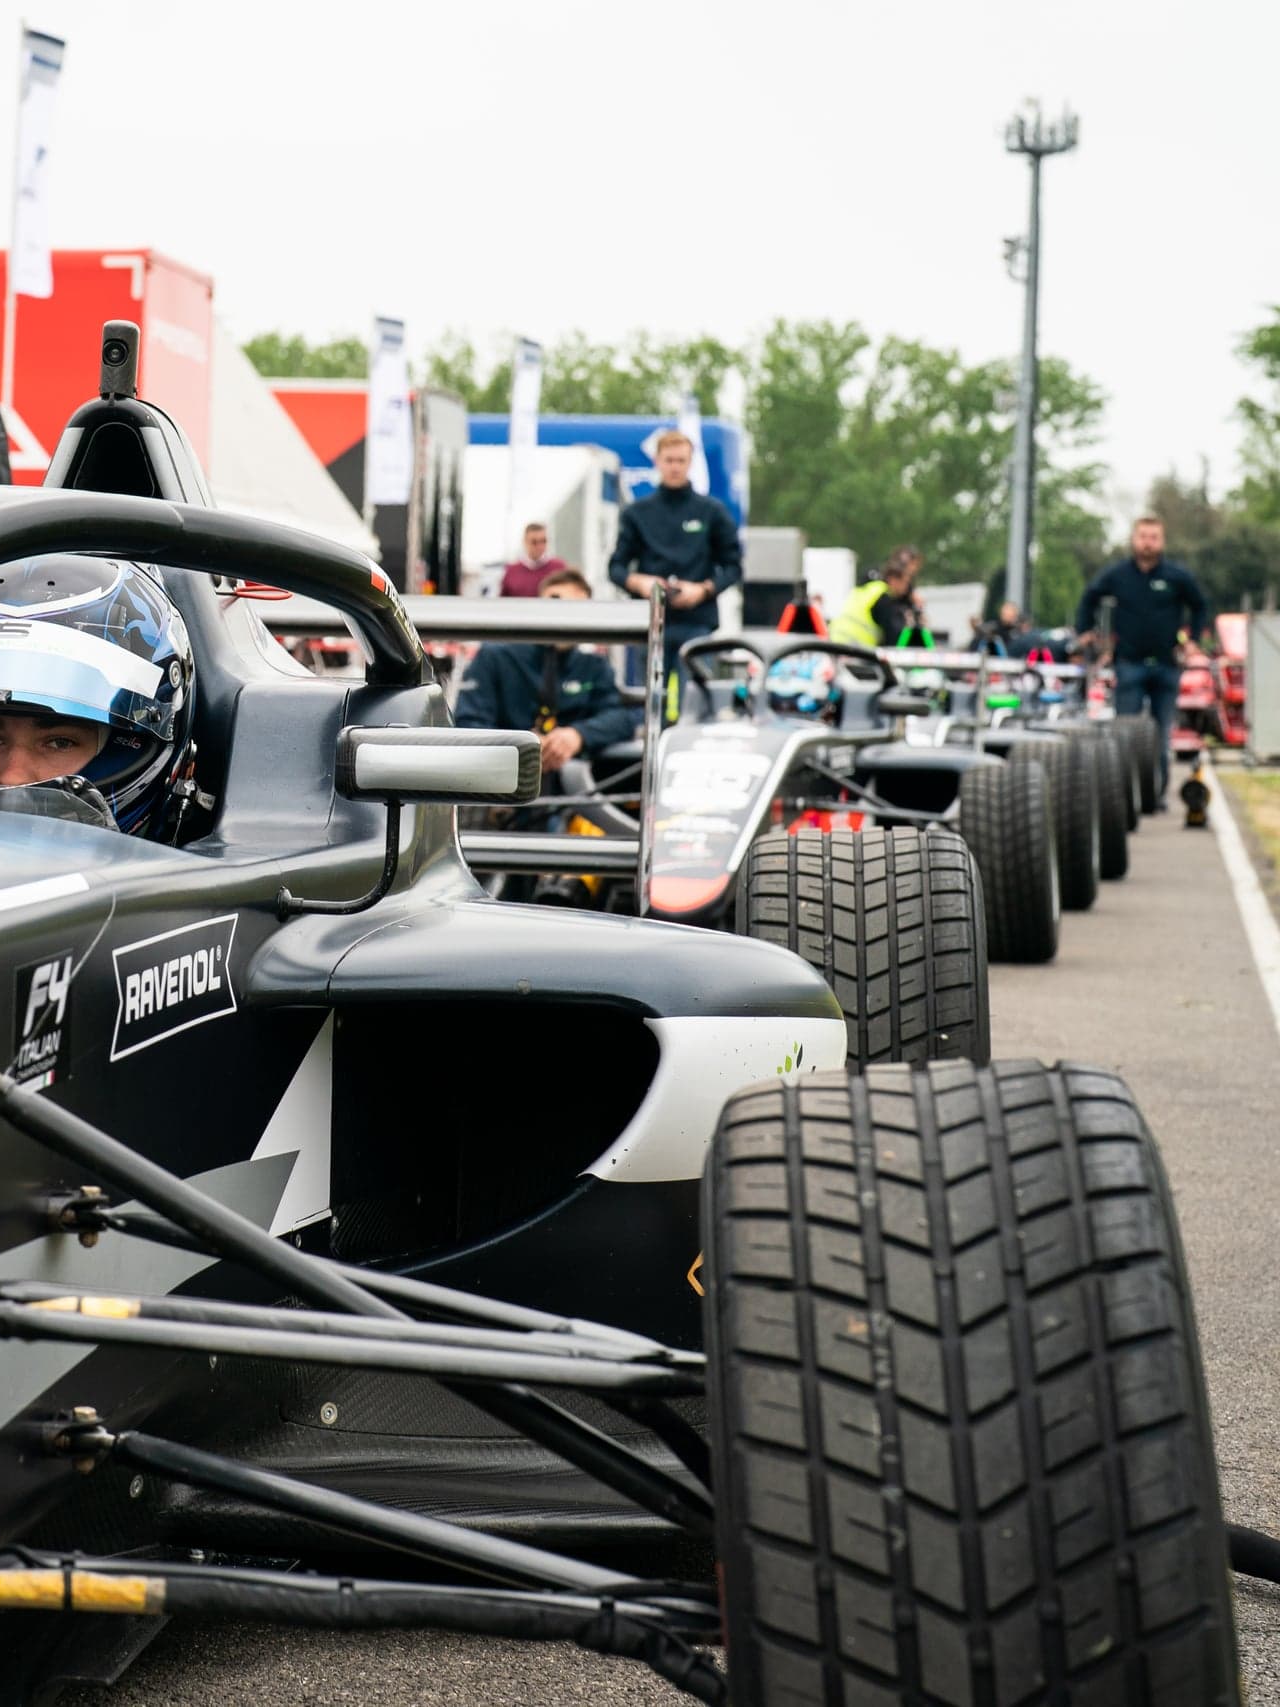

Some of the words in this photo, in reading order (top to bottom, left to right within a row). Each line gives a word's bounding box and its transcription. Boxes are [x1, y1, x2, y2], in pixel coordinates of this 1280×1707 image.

[23, 956, 73, 1037] F4
[125, 947, 221, 1024] RAVENOL
[18, 1029, 62, 1068] ITALIAN
